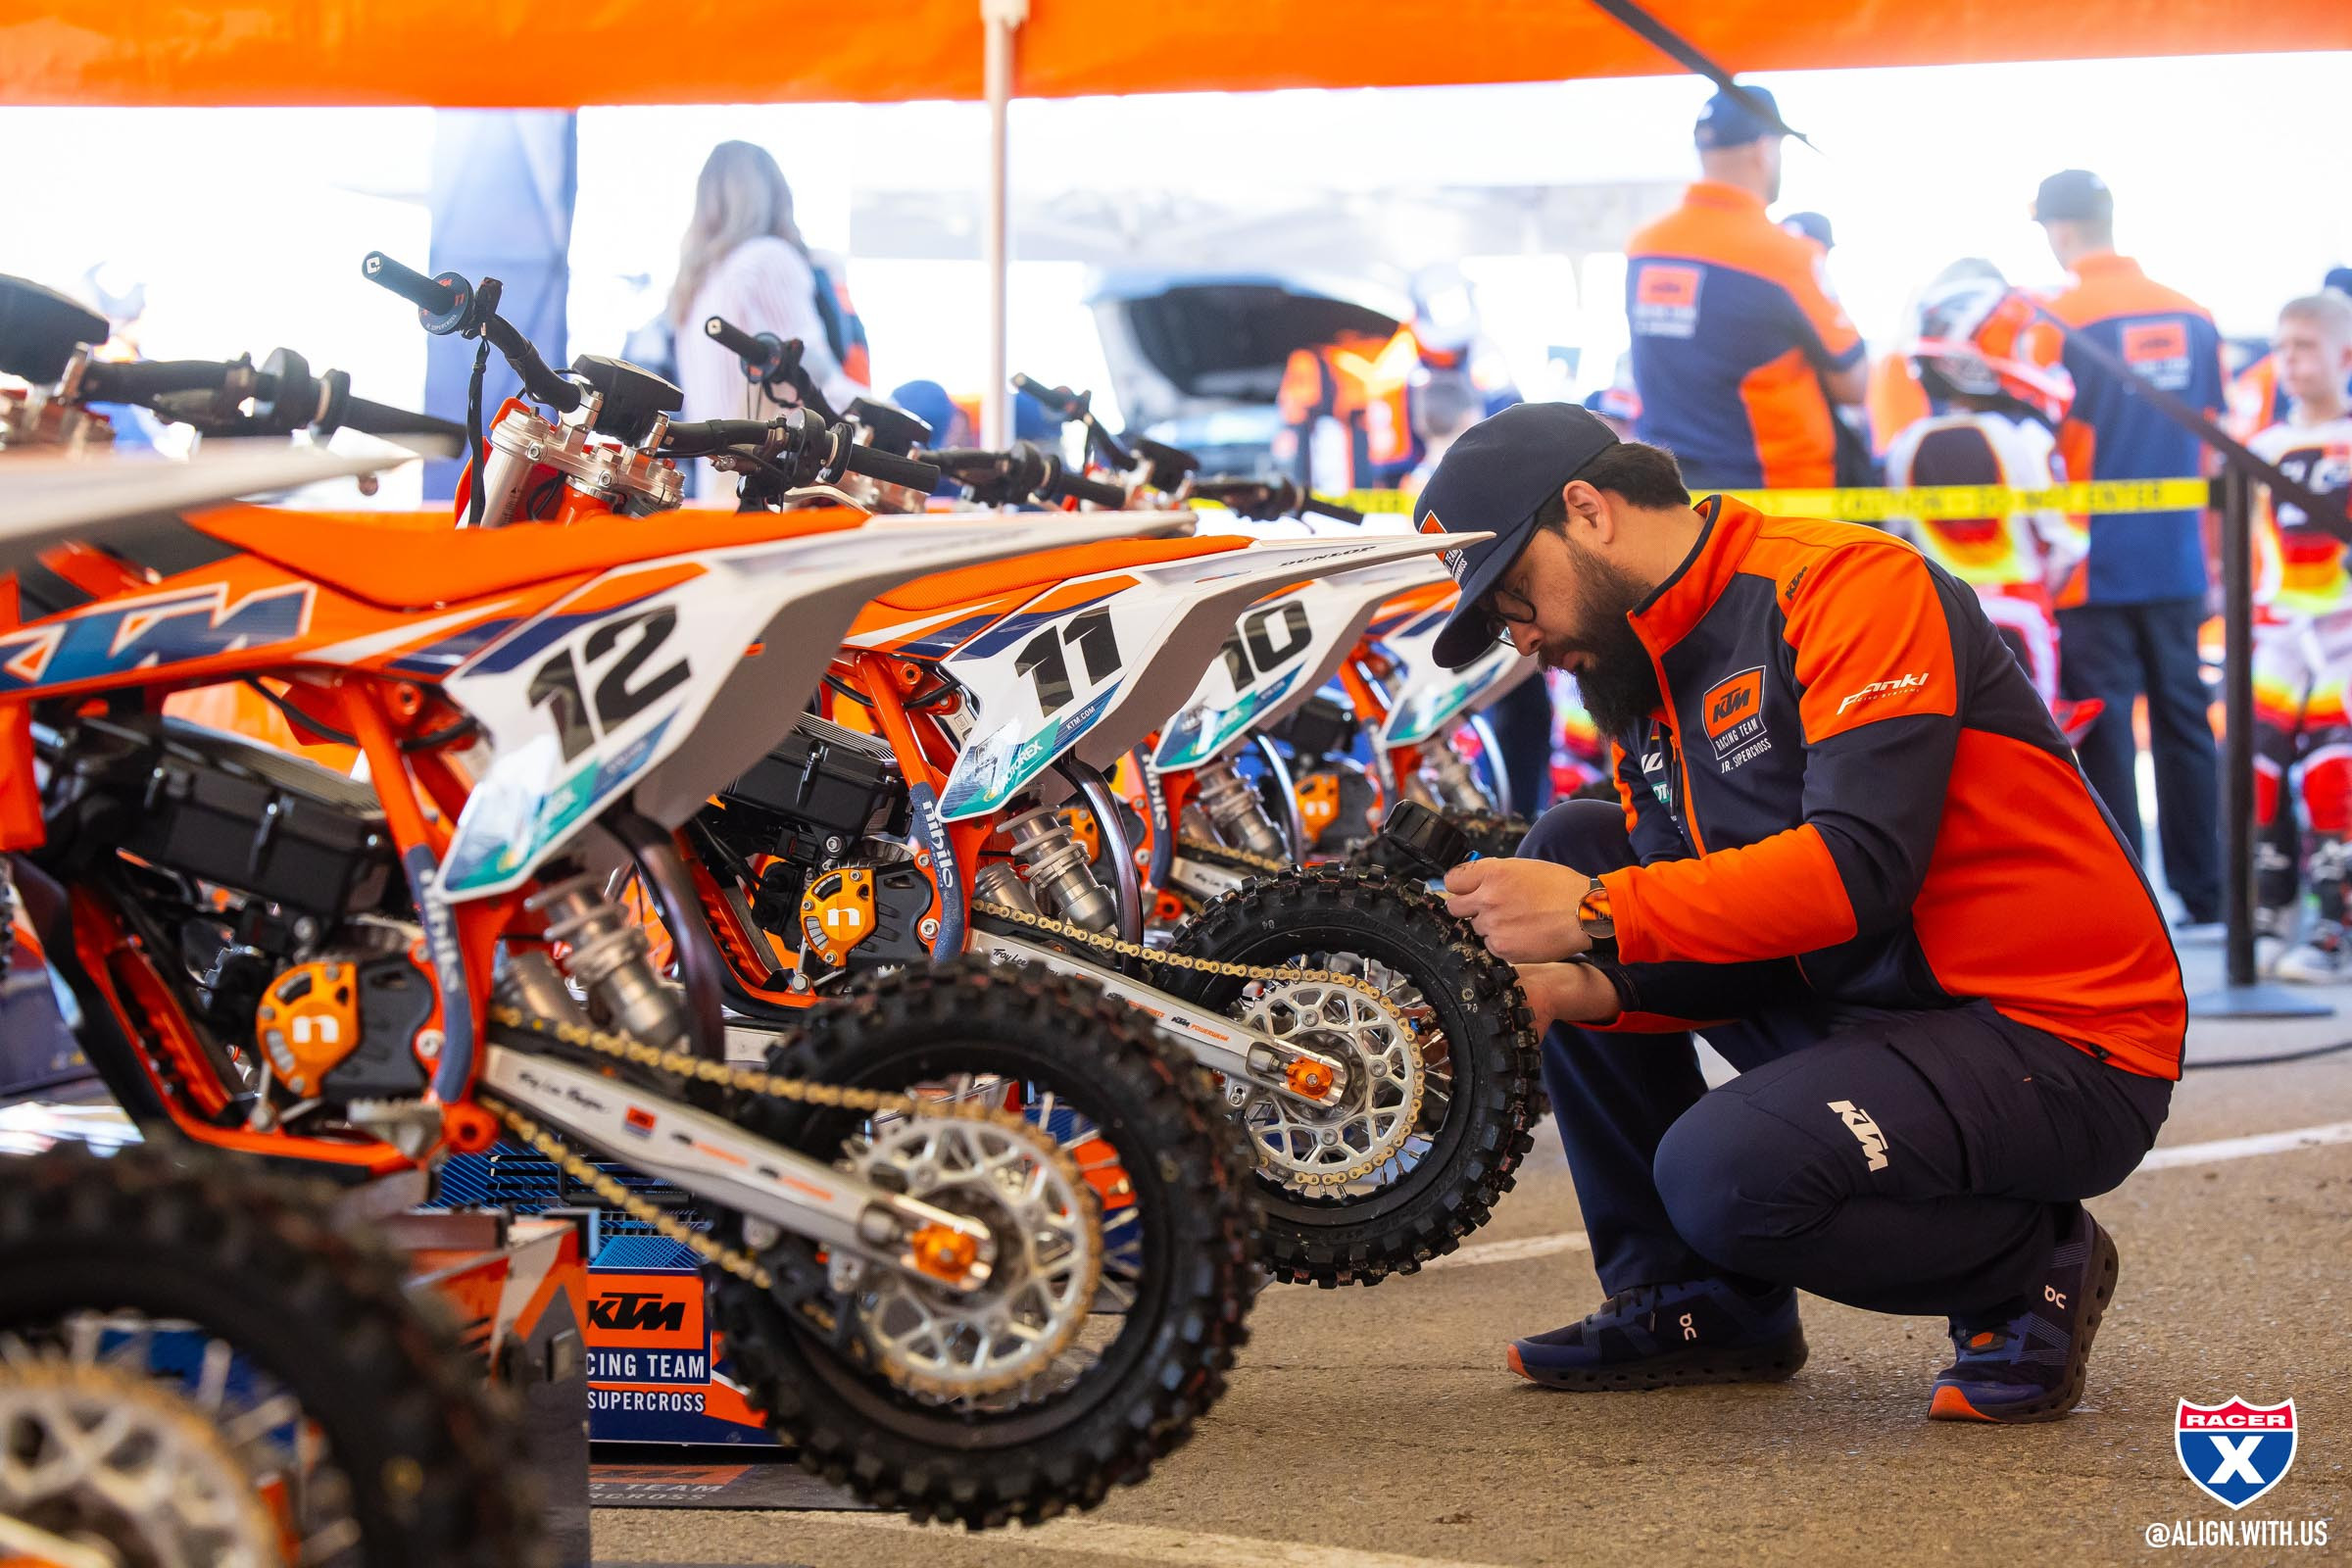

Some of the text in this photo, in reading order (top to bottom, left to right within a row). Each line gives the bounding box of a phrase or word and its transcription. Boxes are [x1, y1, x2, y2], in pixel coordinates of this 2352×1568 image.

[1785, 565, 1808, 601] KTM
[1014, 605, 1123, 718] 11
[1213, 599, 1313, 693] 10
[527, 603, 692, 764] 12
[1065, 706, 1096, 731] KTM.COM
[1712, 687, 1751, 724] KTM
[1715, 717, 1759, 752] RACING TEAM
[1721, 737, 1772, 774] JR. SUPERCROSS
[826, 907, 860, 926] n
[993, 948, 1028, 966] Troy Lee
[1170, 1016, 1191, 1028] KTM
[1826, 1100, 1889, 1172] KTM
[588, 1292, 685, 1331] KTM
[647, 1354, 705, 1379] TEAM
[588, 1391, 706, 1412] SUPERCROSS
